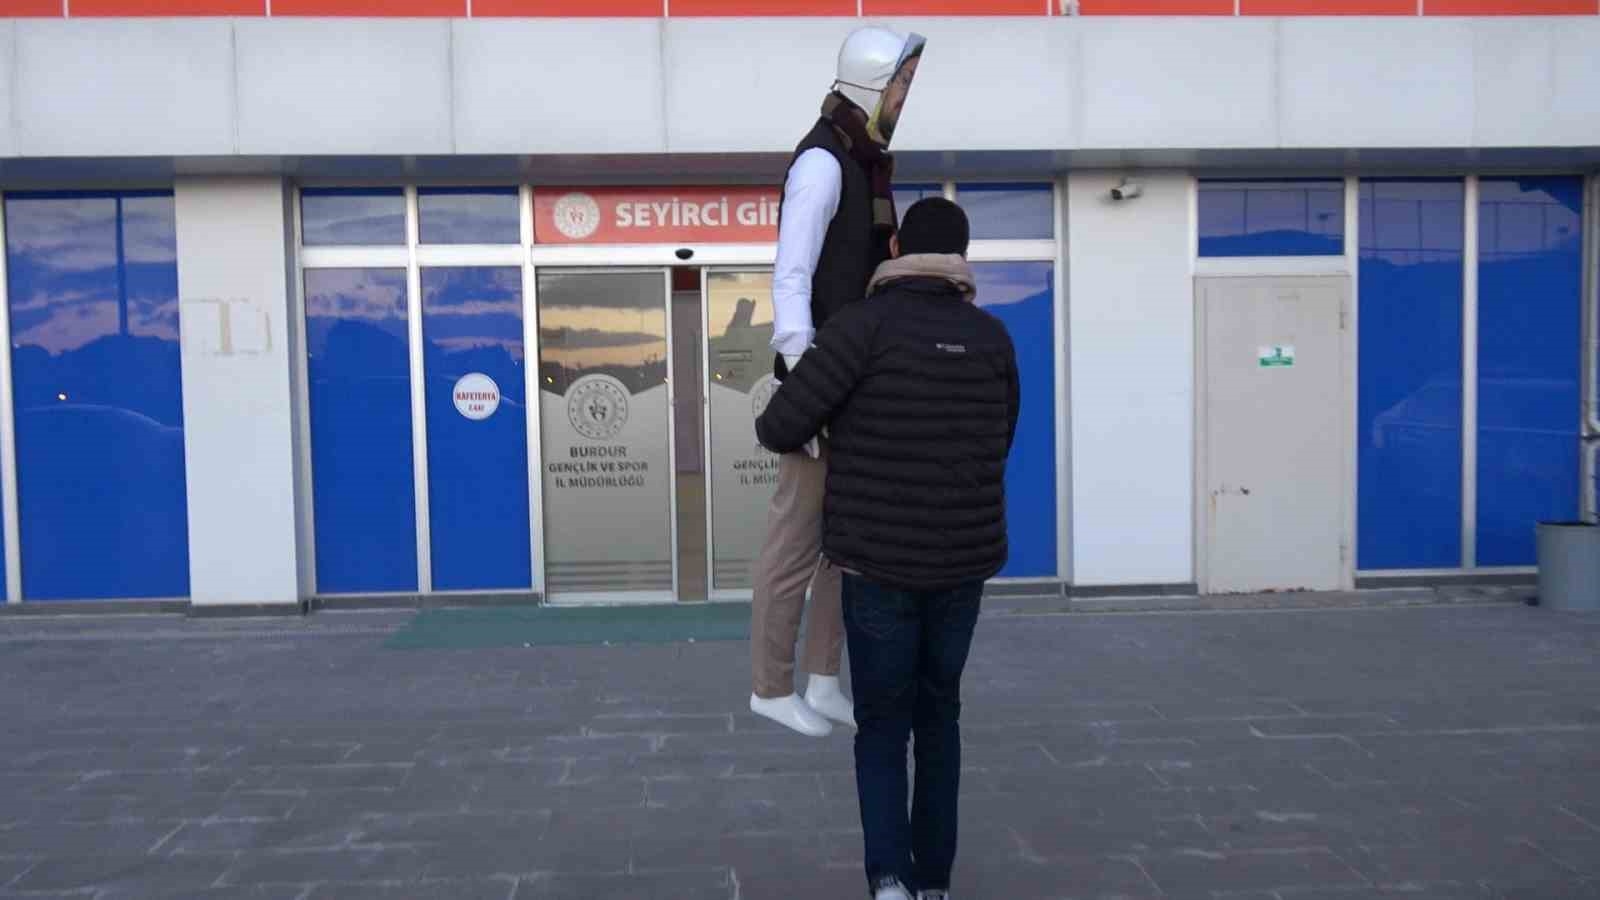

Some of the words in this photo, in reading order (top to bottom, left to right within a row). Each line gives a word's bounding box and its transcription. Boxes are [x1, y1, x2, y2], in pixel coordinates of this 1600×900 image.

[614, 197, 729, 228] SEYİRCİ
[569, 446, 627, 458] BURDUR
[548, 461, 597, 475] GENÇLİK
[600, 462, 615, 472] VE
[617, 461, 649, 473] SPOR
